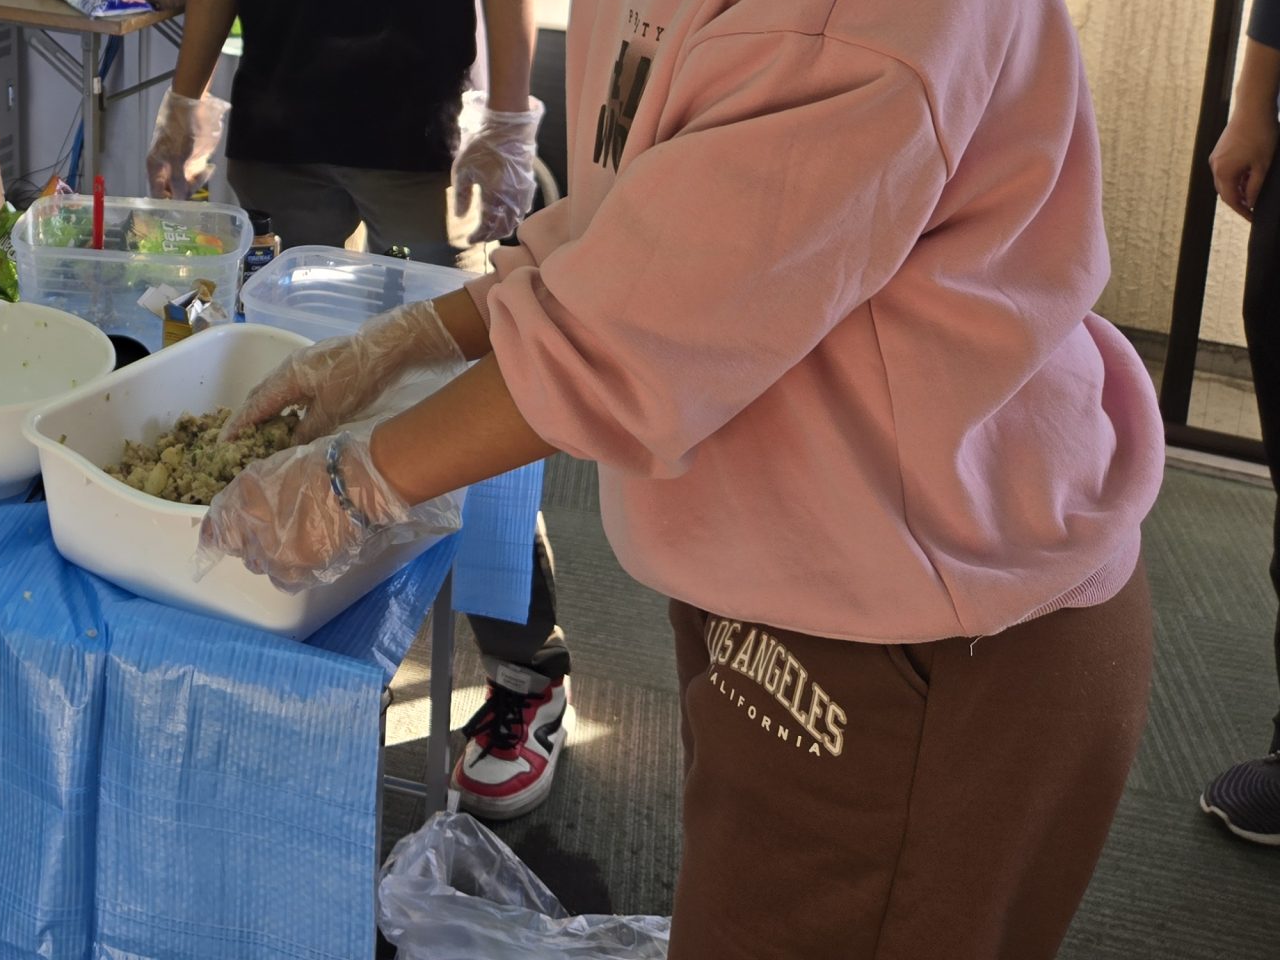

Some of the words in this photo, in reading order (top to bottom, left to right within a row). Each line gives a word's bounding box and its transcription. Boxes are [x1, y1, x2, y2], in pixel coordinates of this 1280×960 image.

[706, 618, 742, 667] LOS
[730, 627, 848, 757] ANGELES
[706, 665, 821, 757] ALIFORNIA
